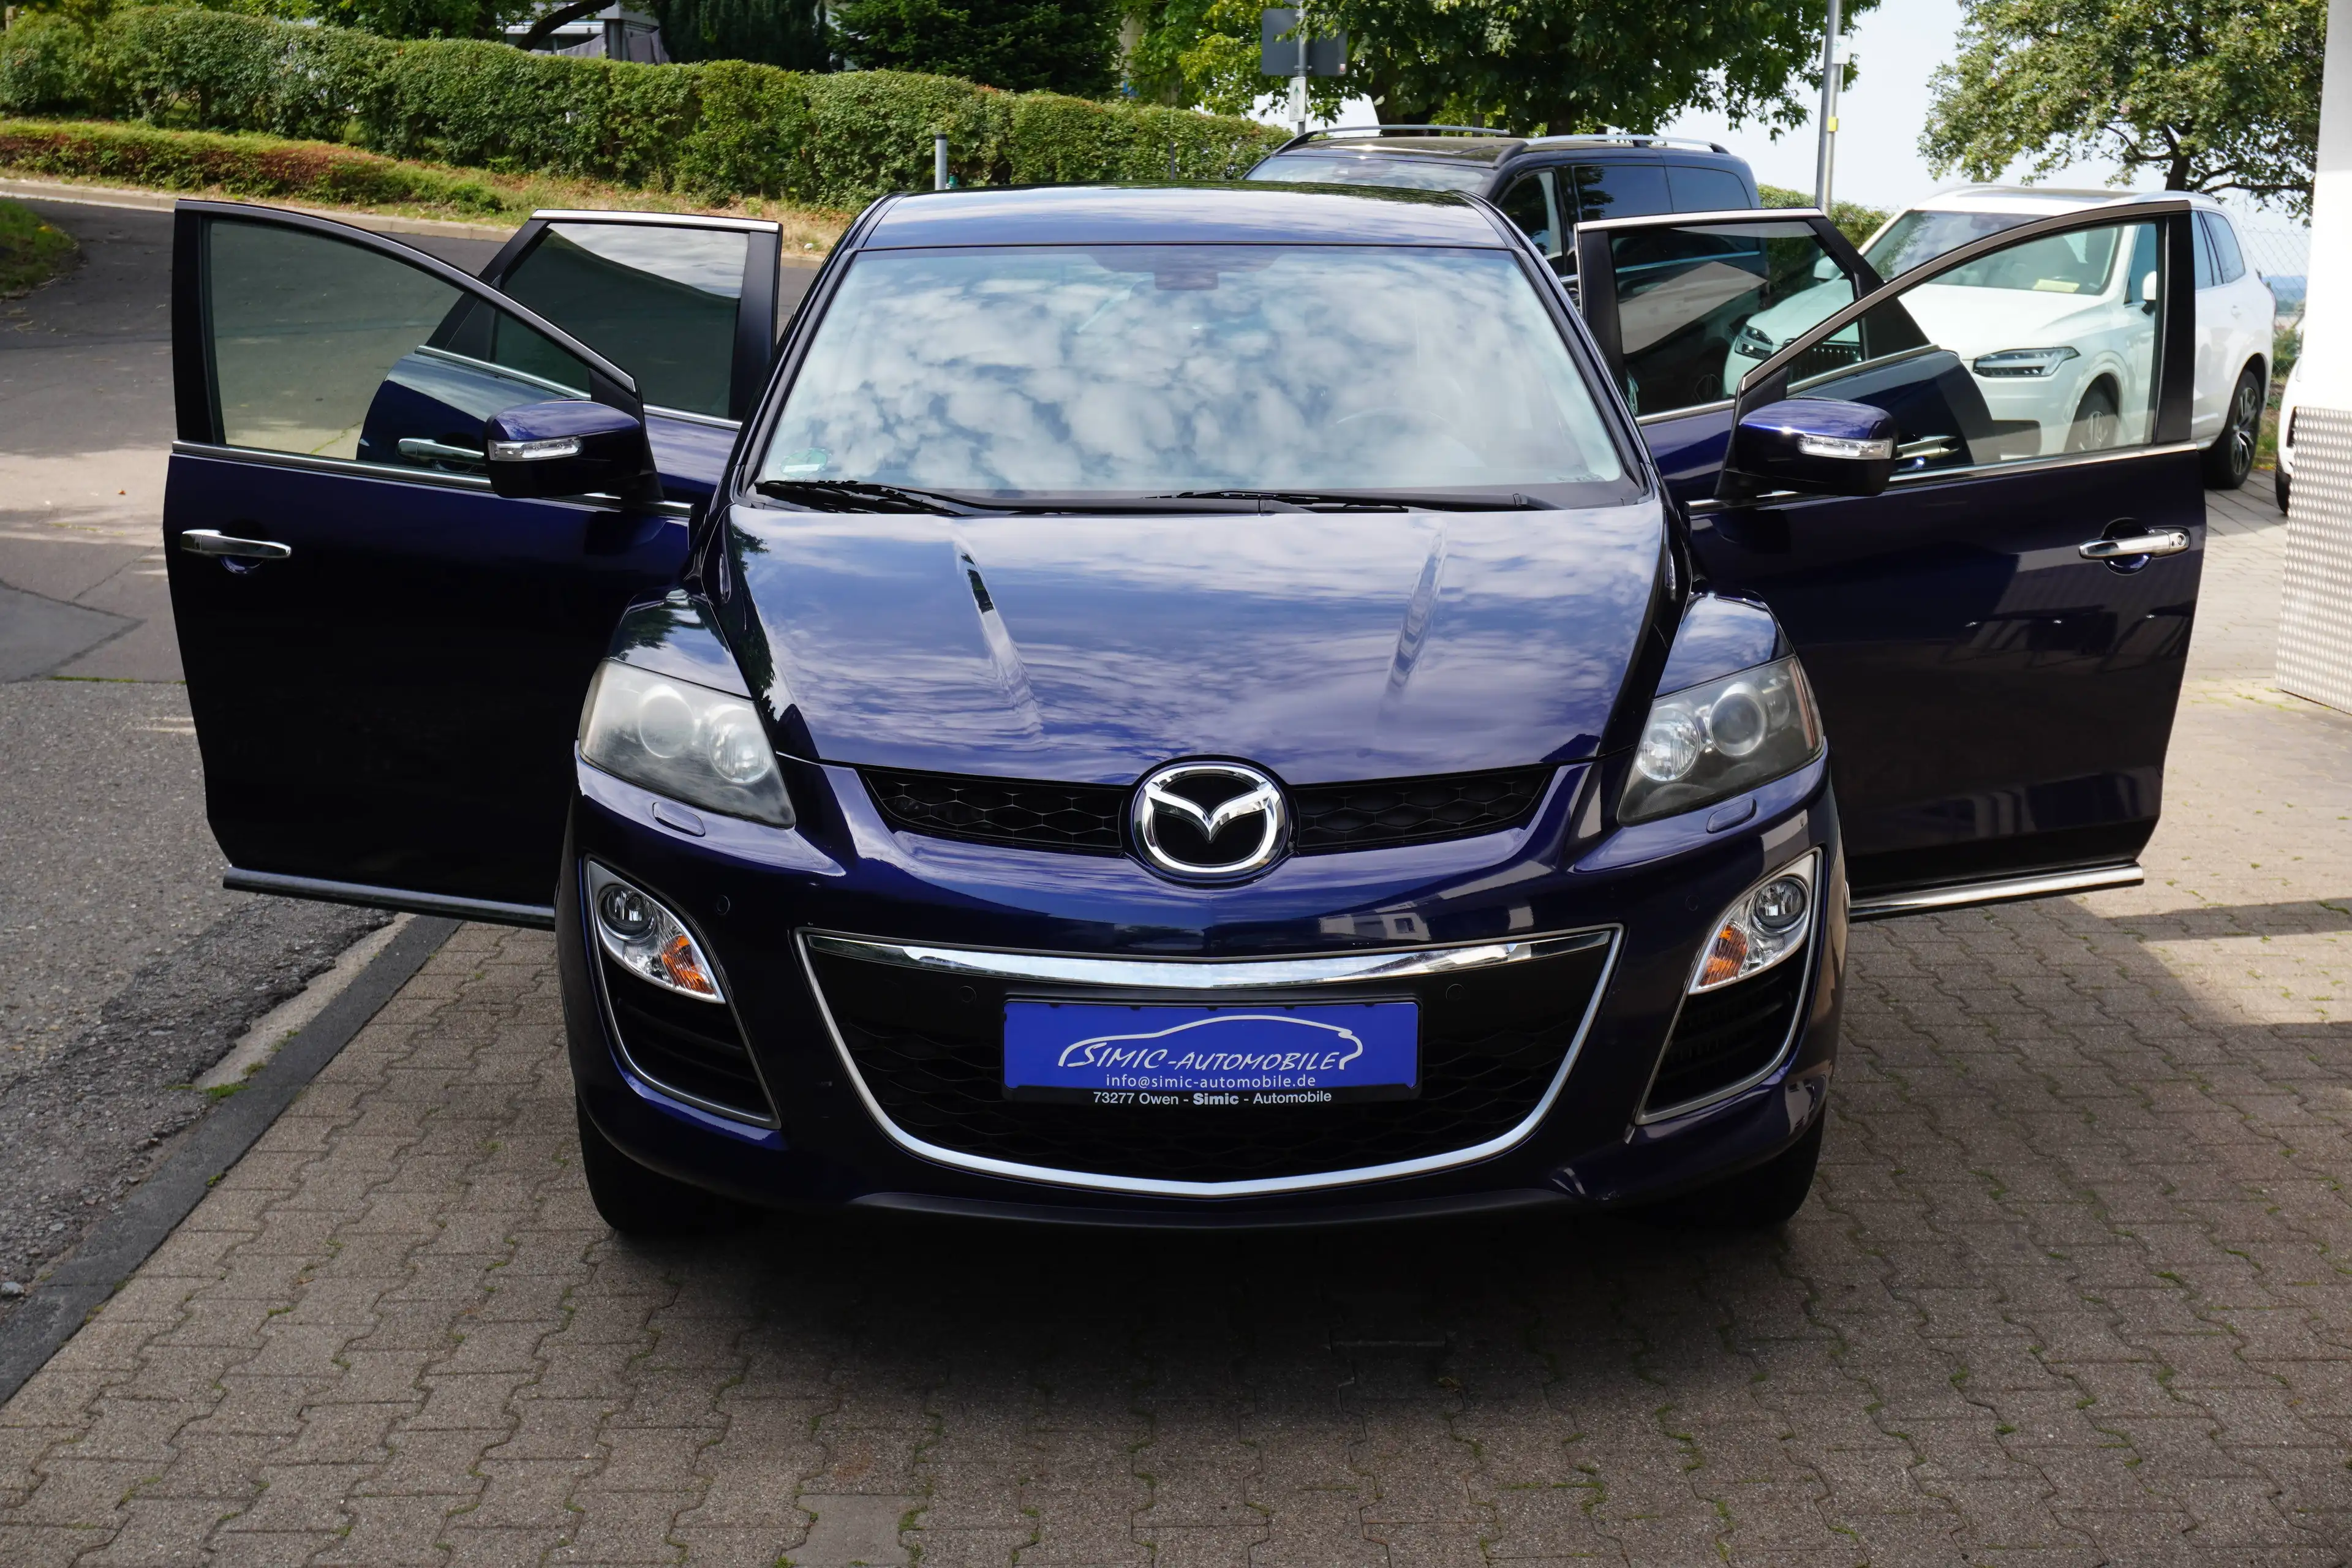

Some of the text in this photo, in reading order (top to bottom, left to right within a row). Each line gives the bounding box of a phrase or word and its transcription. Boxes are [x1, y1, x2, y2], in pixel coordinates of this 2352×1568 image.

[1067, 1042, 1340, 1071] SIMIC-AUTOMOBILE
[1106, 1074, 1316, 1088] info@simic-automobile.de
[1093, 1091, 1134, 1104] 73277
[1139, 1092, 1179, 1105] Owen
[1193, 1092, 1239, 1106] Simic
[1253, 1090, 1332, 1104] Automobile
